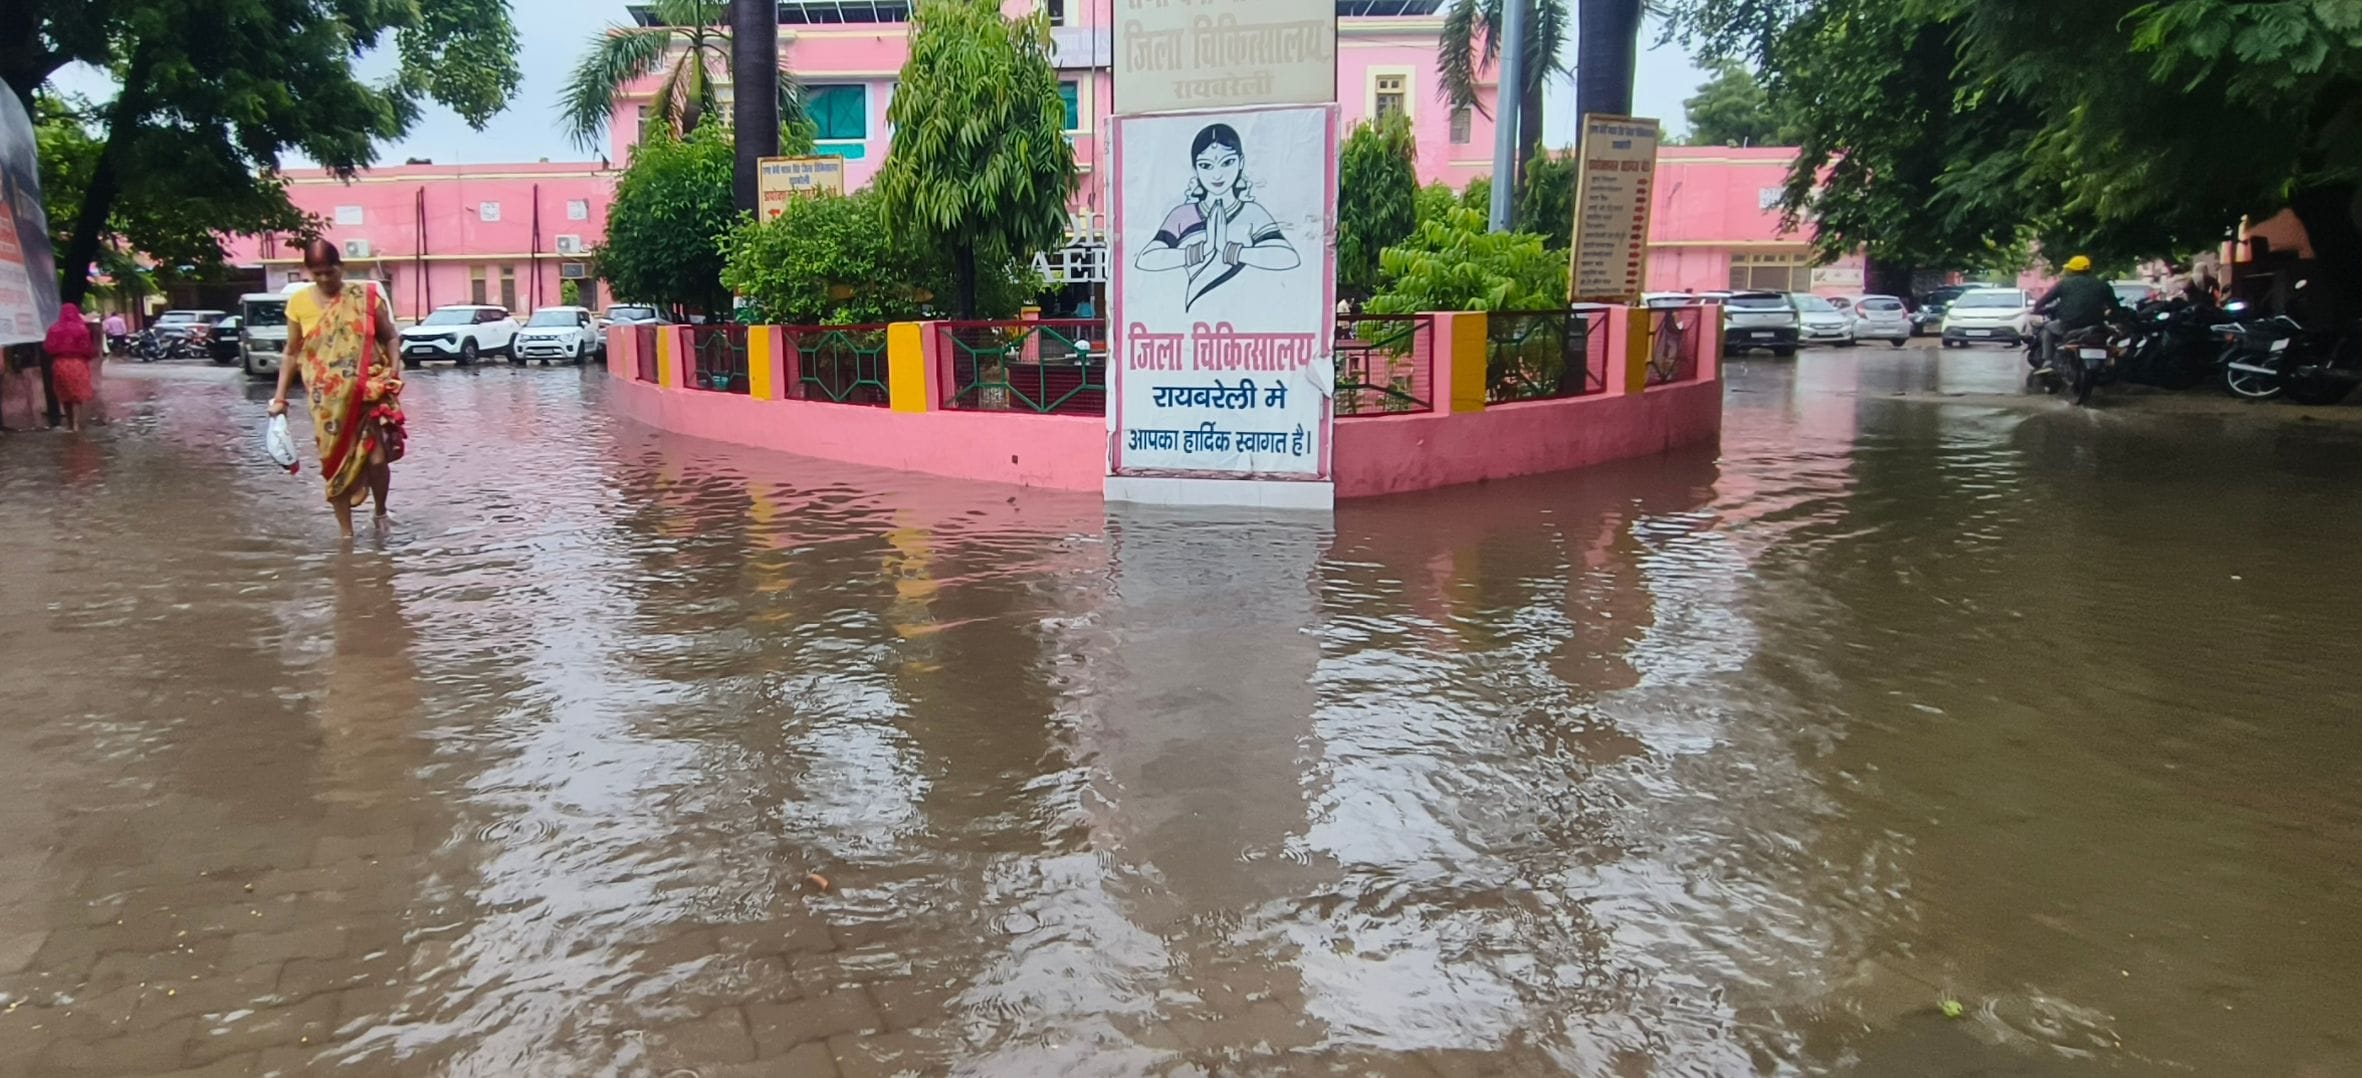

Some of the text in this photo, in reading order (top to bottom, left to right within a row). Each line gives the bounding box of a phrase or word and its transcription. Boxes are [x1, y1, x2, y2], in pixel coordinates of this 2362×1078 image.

[1124, 19, 1184, 73] जिला
[1172, 70, 1275, 99] रायबरेली
[1128, 321, 1315, 371] जिला चिकित्सालय
[1152, 378, 1257, 409] रायबरेली
[1128, 429, 1179, 451] आपका
[1183, 421, 1231, 453] हार्दिक
[1235, 430, 1287, 454] स्वागत
